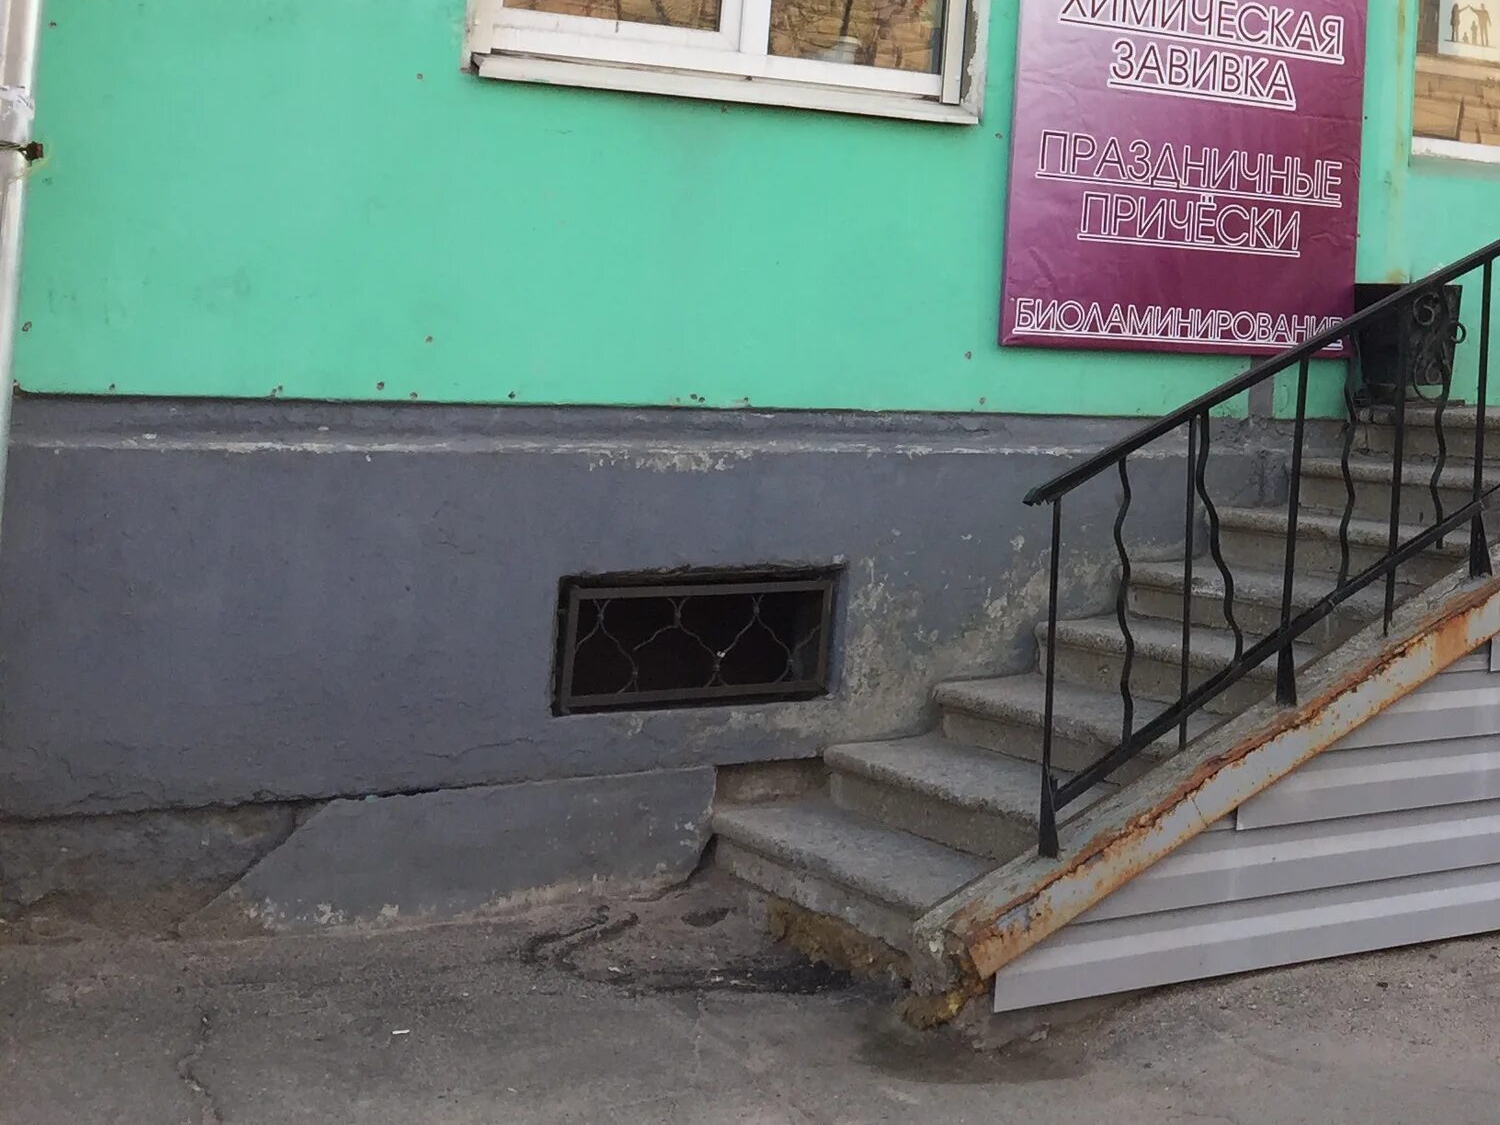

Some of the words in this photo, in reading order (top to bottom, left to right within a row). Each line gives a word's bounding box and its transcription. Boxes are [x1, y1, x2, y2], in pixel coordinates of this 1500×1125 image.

[1110, 39, 1296, 102] ЗАВИВКА
[1038, 130, 1343, 202] ПРАЗДНИЧНЫЕ
[1080, 191, 1301, 250] ПРИЧЁСКИ
